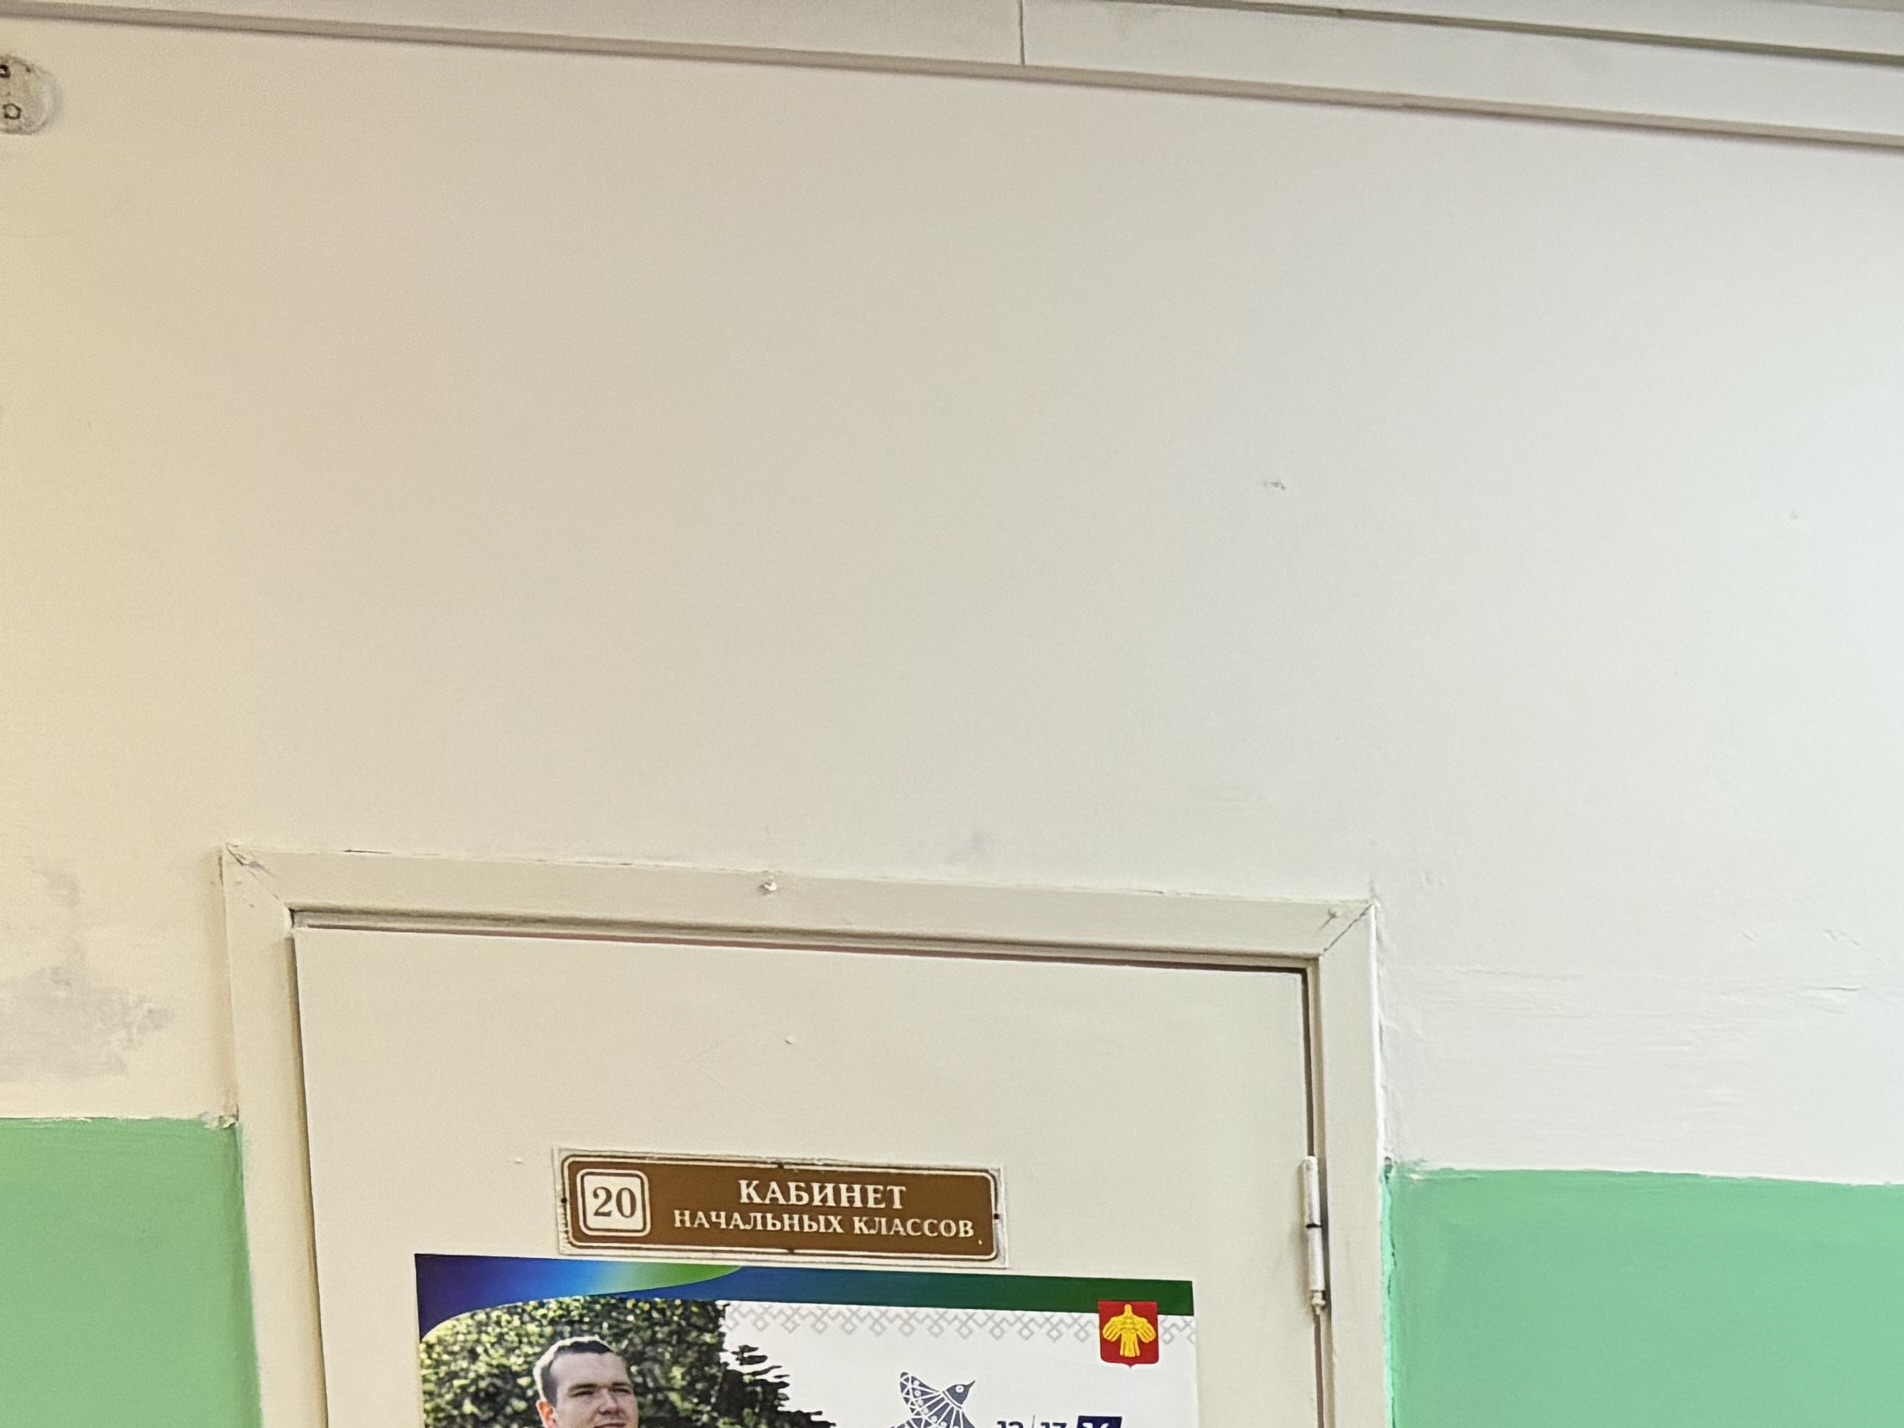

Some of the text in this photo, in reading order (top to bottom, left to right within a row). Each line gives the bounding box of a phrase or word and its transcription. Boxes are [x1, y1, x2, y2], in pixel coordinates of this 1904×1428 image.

[592, 1186, 638, 1219] 20
[738, 1179, 906, 1210] КАБИНЕТ
[673, 1209, 975, 1238] НАЧАЛЬНЫХ КЛАССОВ
